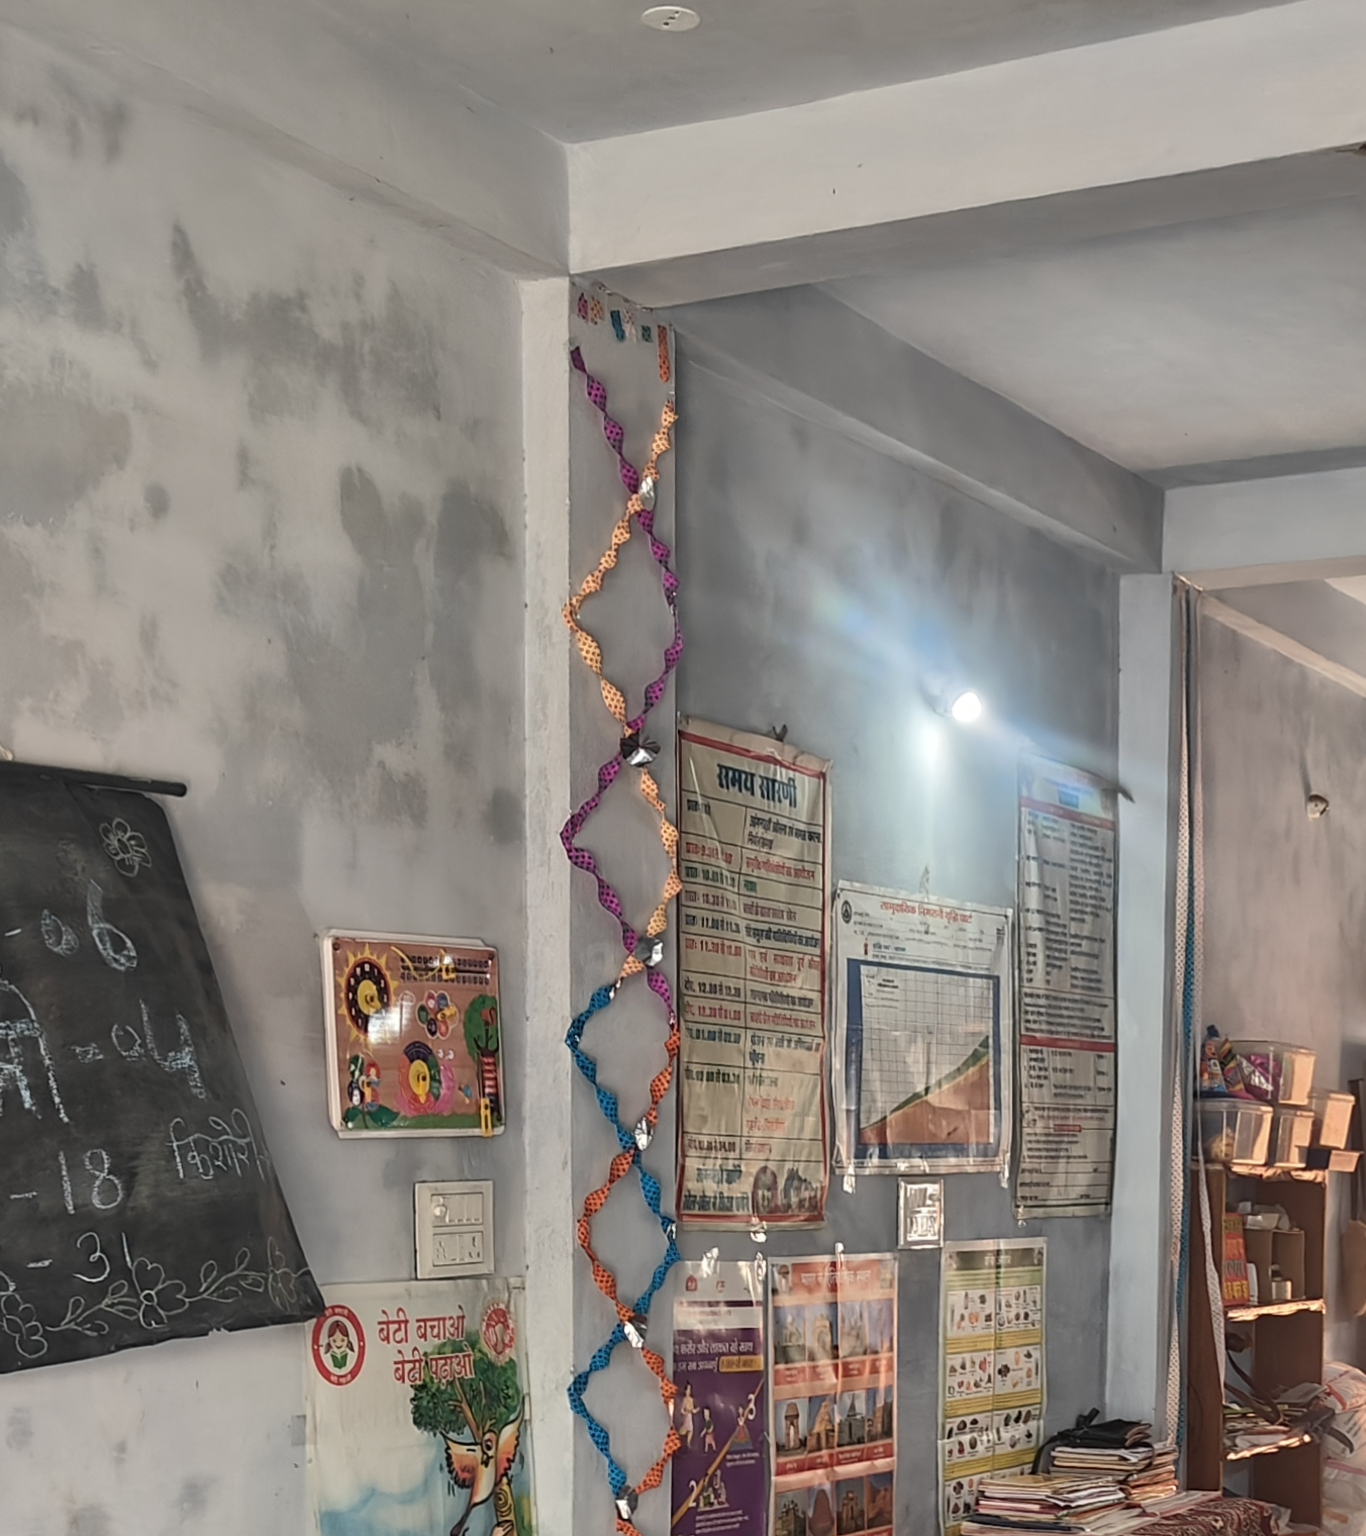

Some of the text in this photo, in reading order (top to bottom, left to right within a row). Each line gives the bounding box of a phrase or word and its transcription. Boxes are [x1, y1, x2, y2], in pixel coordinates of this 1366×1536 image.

[716, 763, 798, 809] समय सारणी
[58, 1148, 124, 1215] 18
[377, 1304, 466, 1345] बेटी बचाओ
[393, 1344, 475, 1389] बेटी पढ़ाओ
